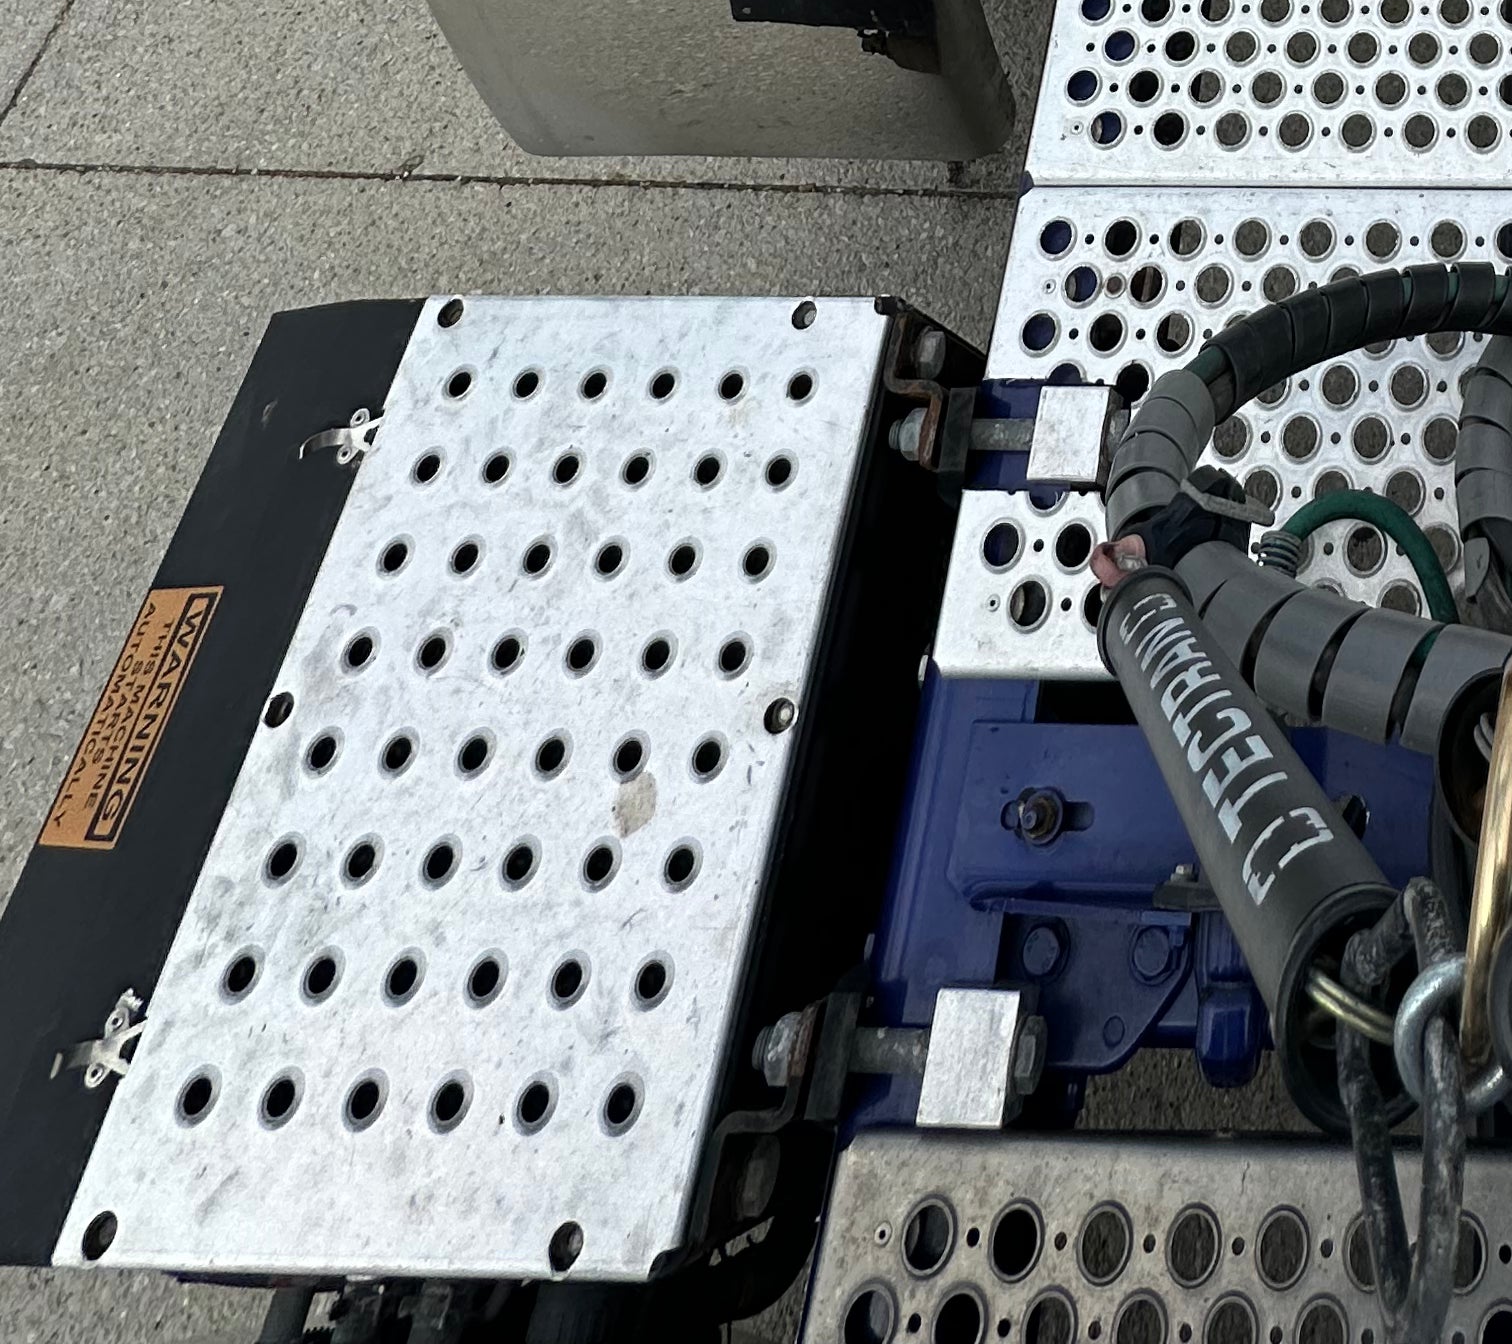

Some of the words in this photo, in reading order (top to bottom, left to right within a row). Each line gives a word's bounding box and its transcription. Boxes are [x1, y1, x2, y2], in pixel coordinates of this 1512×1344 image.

[53, 602, 156, 827] AUTOMATICALLY
[91, 660, 143, 764] STARTS
[101, 610, 204, 821] WARNING
[143, 618, 174, 675] THIS
[1135, 616, 1288, 844] TECTRAN
[84, 684, 145, 809] MACHINE
